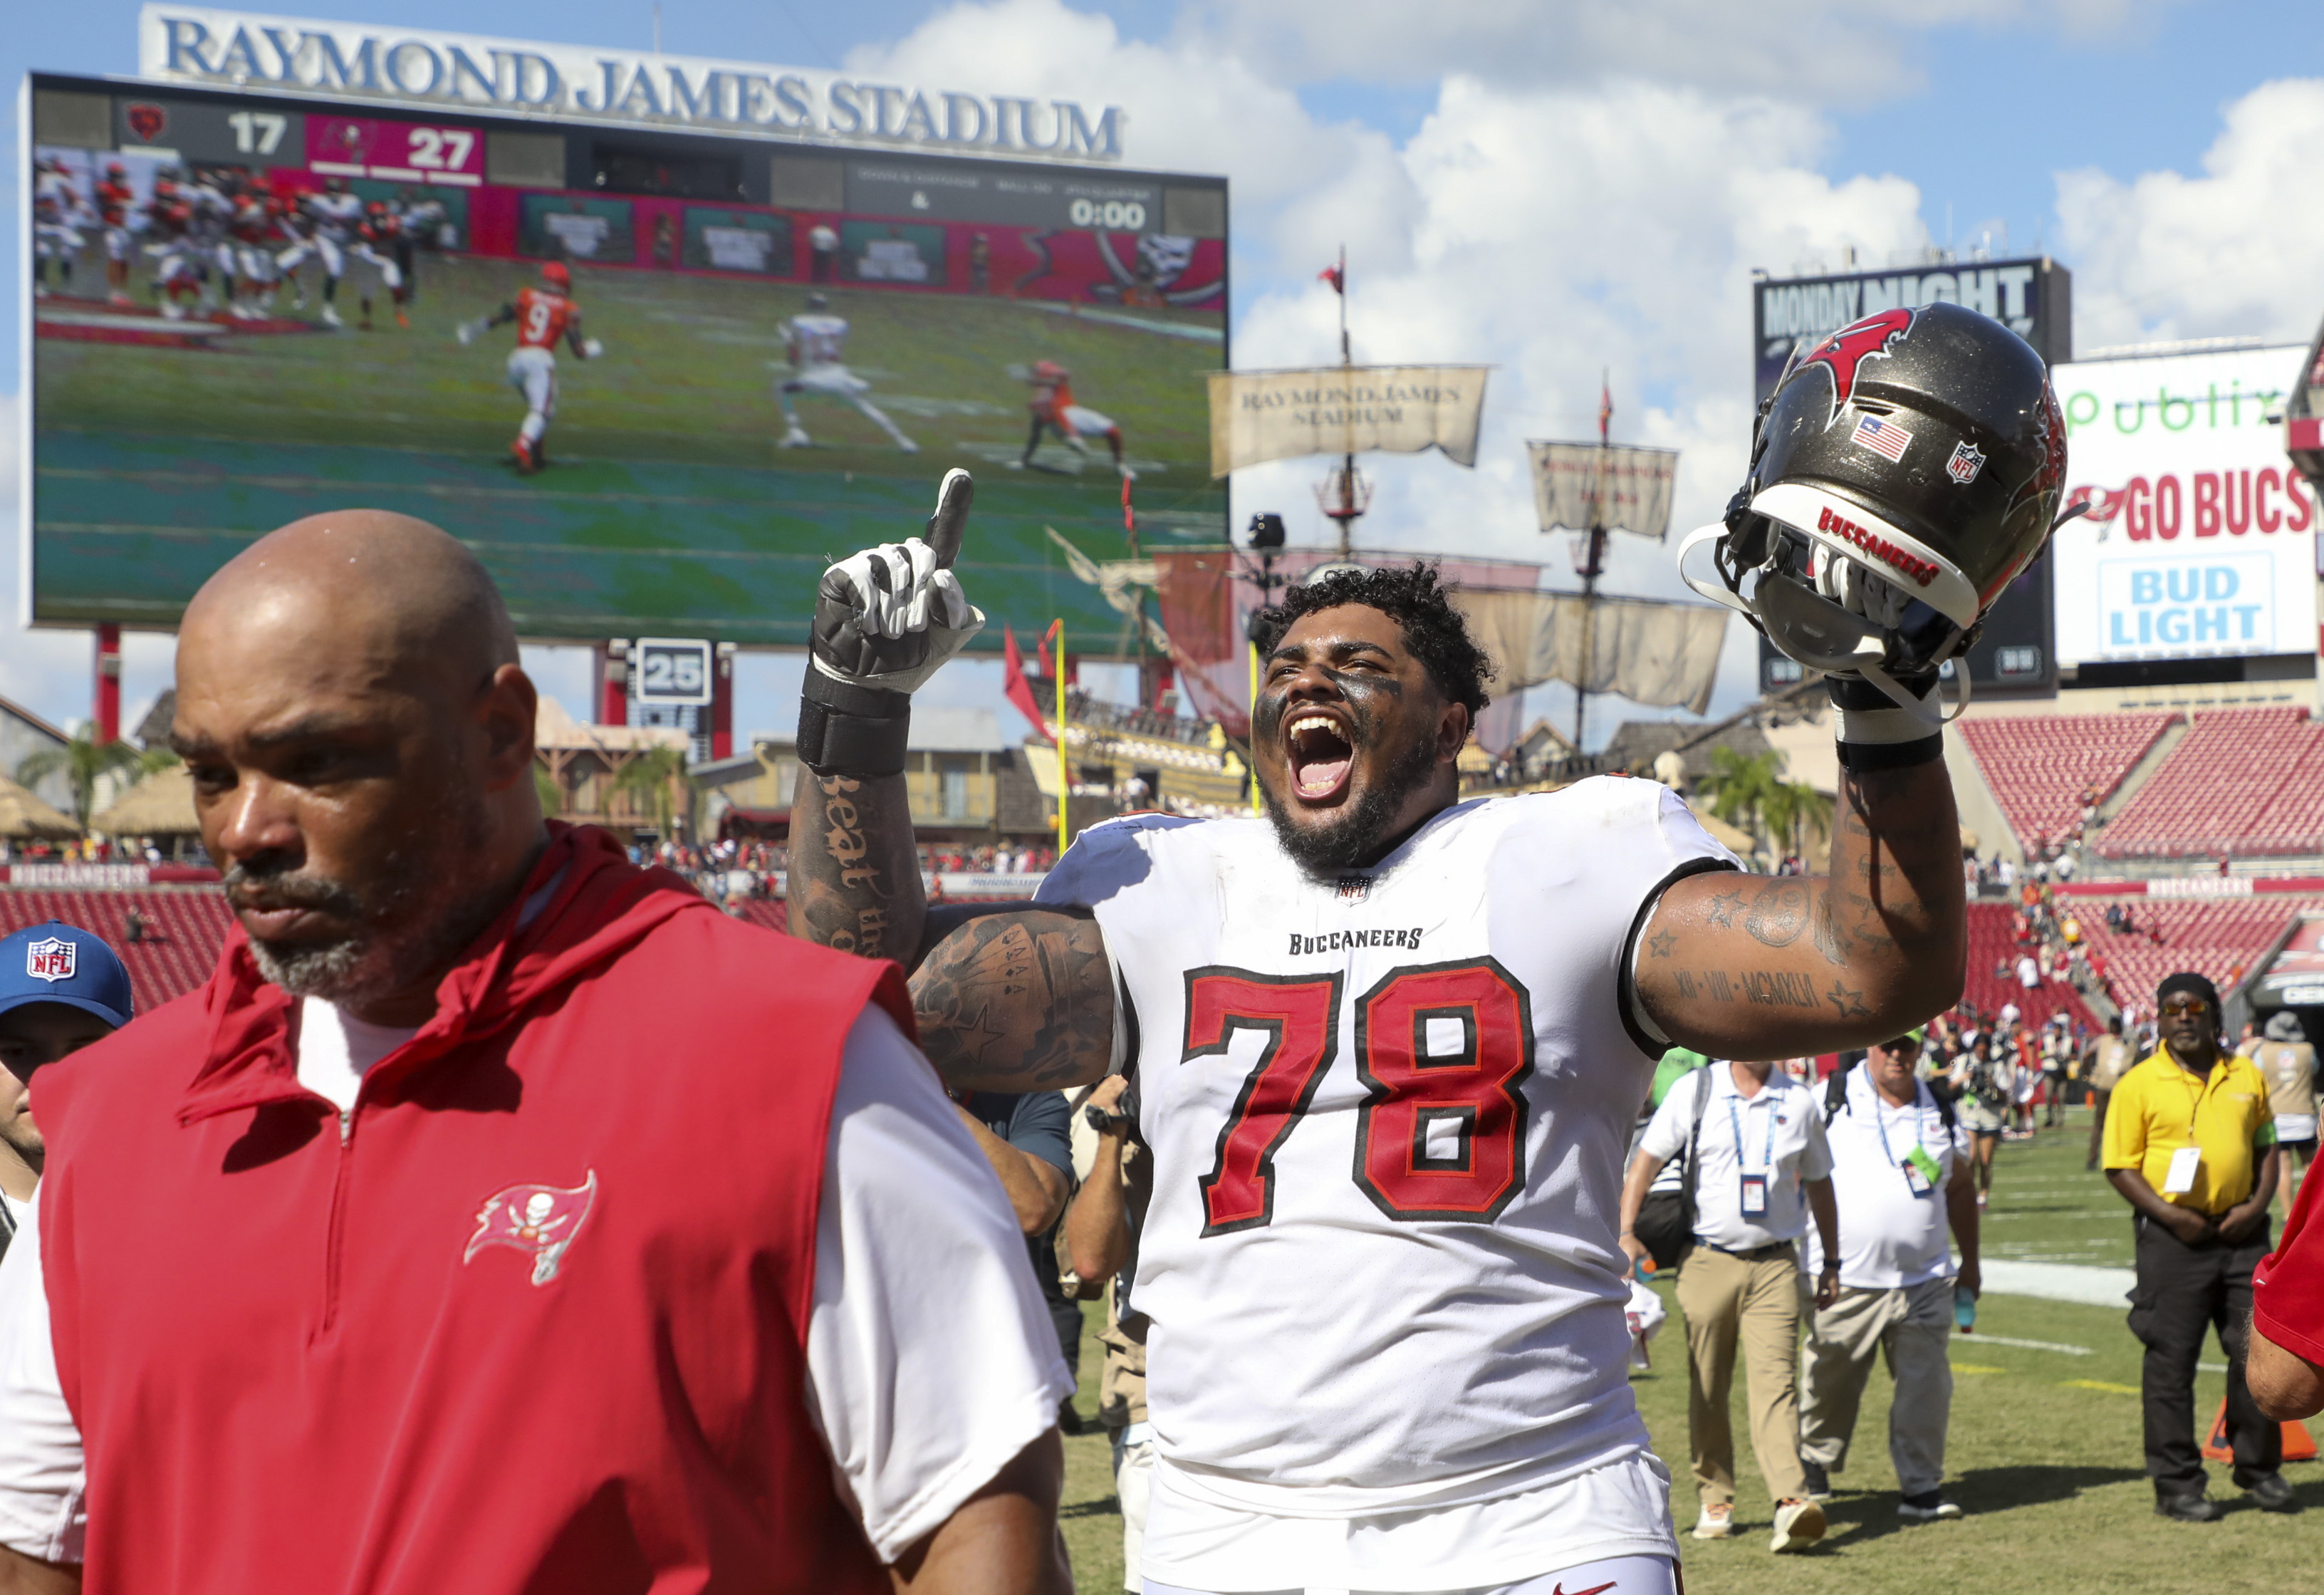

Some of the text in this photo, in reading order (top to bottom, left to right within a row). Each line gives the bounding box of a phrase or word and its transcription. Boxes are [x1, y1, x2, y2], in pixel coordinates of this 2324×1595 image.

[160, 18, 1123, 155] RAYMOND JAMES STADIUM
[229, 112, 286, 155] 17
[408, 127, 475, 170] 27
[1070, 198, 1146, 230] 0:00
[524, 301, 551, 342] 9
[1763, 266, 2034, 339] MONDAY NIGHT
[1241, 383, 1460, 411] RAYMOND JAMES
[1292, 407, 1402, 426] STADIUM
[1951, 455, 1981, 480] NFL
[2126, 466, 2312, 541] GO BUCS
[1818, 505, 1942, 588] BUCCANEERS
[2131, 565, 2240, 606] BUD
[2110, 604, 2263, 646] LIGHT
[644, 653, 703, 692] 25
[1340, 885, 1365, 900] NFL
[1288, 928, 1424, 956] BUCCANEERS
[33, 954, 70, 975] NFL
[1180, 955, 1534, 1239] 78
